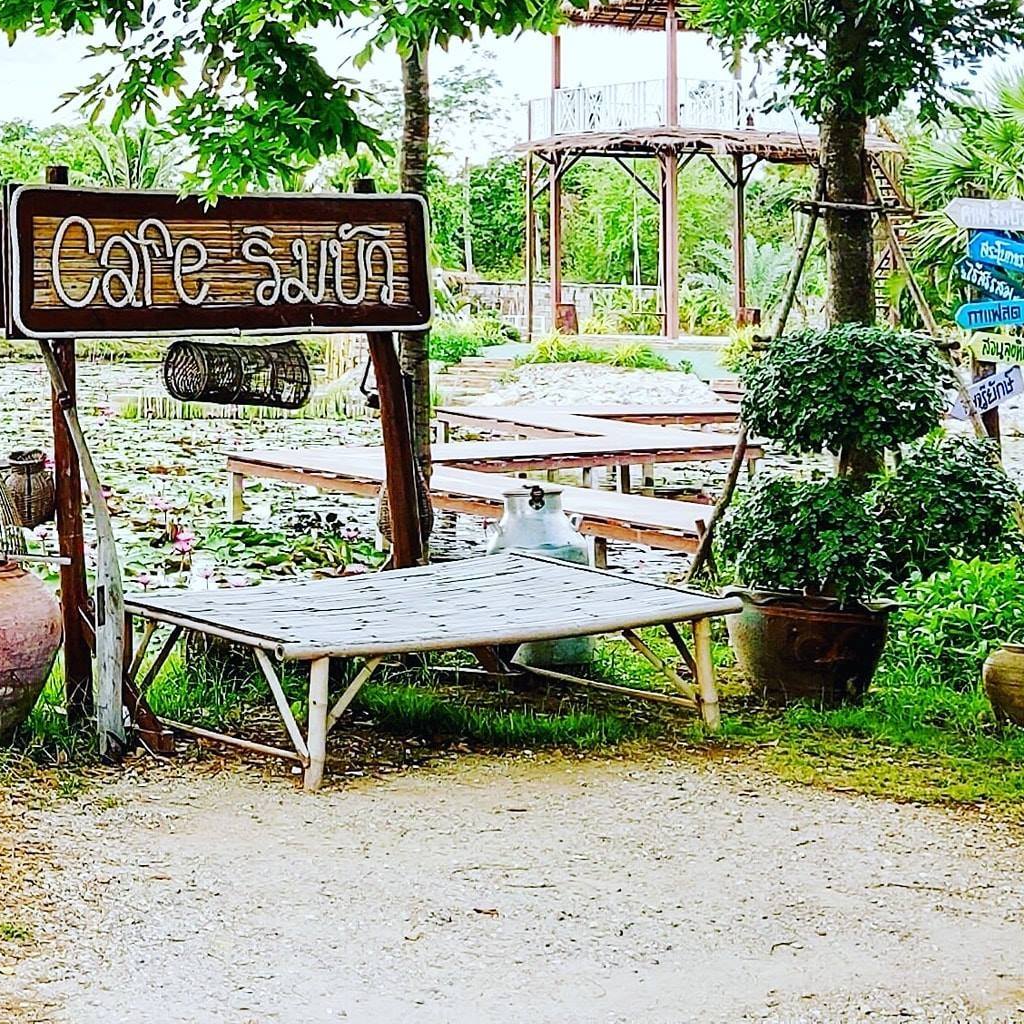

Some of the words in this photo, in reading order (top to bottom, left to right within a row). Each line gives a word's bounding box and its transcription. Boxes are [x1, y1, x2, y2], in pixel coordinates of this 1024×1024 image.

[52, 216, 210, 307] Cafe
[242, 223, 394, 305] ริมบัว
[967, 302, 1021, 325] กาแฟสด
